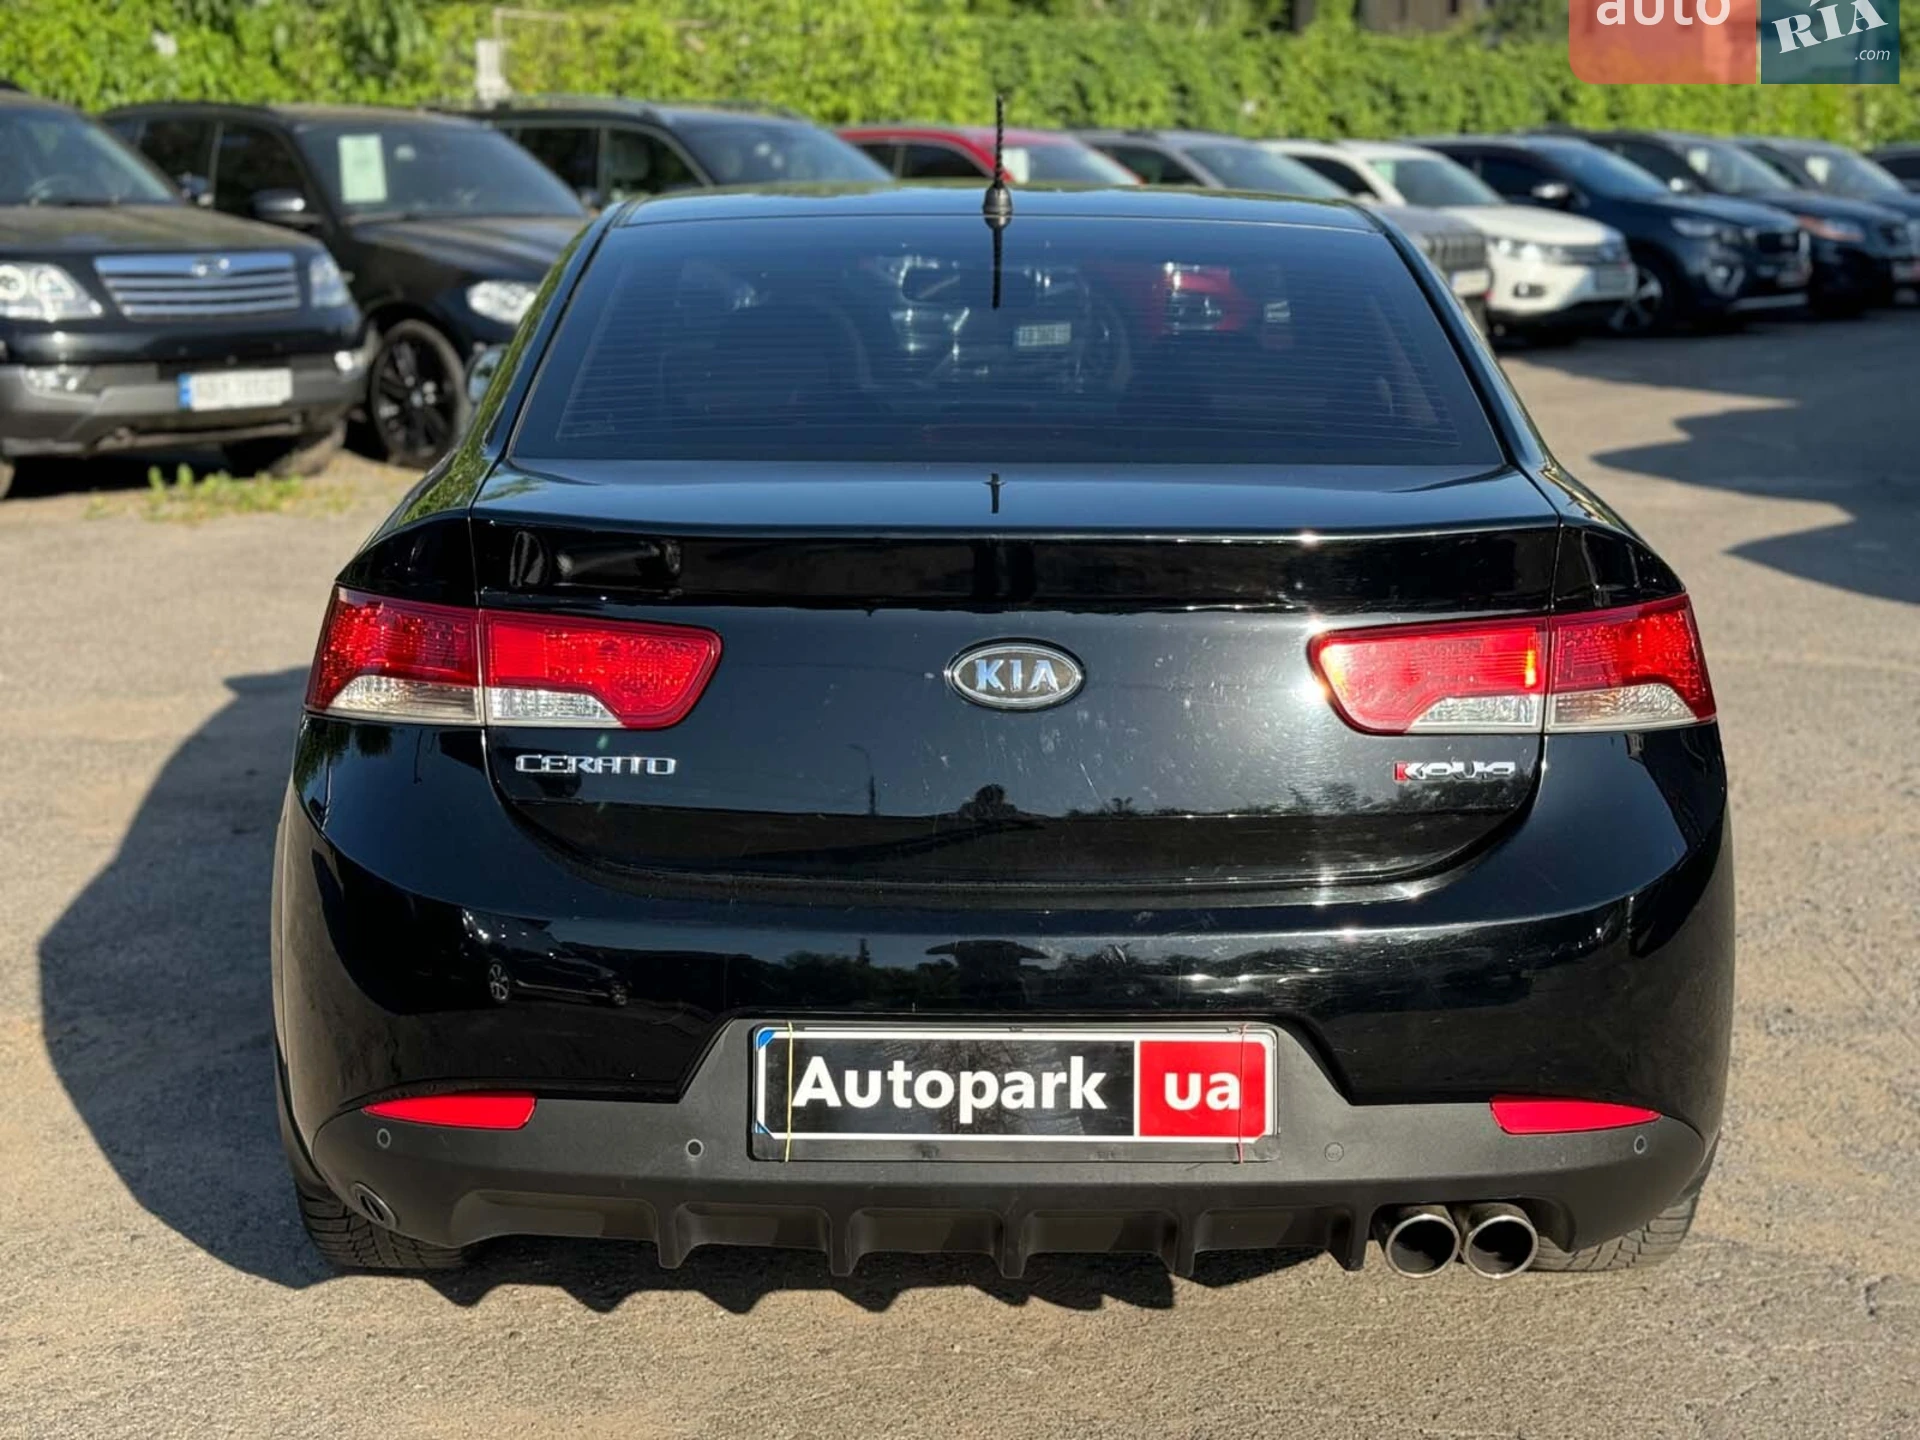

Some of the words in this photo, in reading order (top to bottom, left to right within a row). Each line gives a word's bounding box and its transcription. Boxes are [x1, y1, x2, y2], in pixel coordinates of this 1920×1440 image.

[975, 659, 1060, 692] KIA
[515, 754, 677, 774] CERATO
[791, 1056, 1108, 1123] Autopark
[1164, 1072, 1241, 1110] ua
